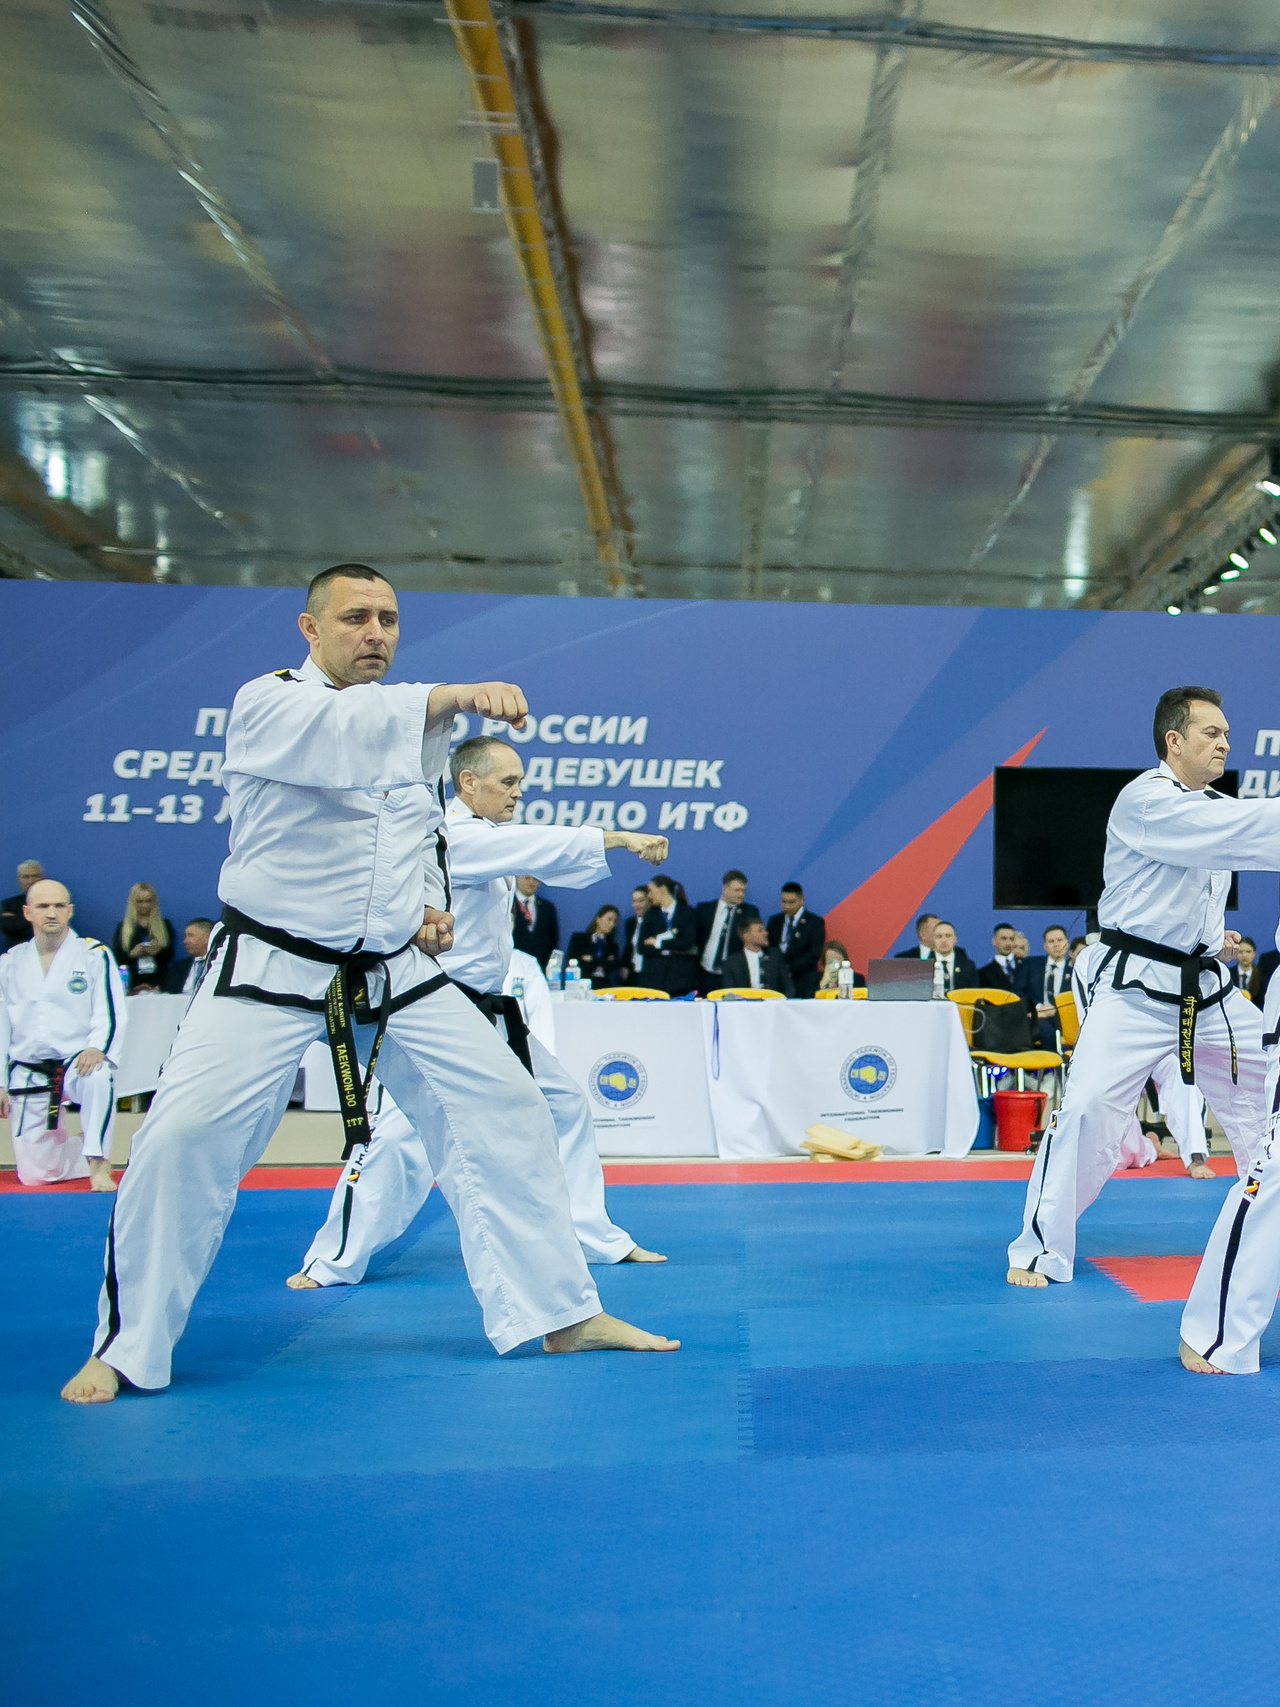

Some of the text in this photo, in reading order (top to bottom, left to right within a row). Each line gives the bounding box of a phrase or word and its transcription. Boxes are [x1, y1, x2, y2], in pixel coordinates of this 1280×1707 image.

[481, 714, 649, 745] РОССИИ
[113, 749, 224, 787] СРЕД
[519, 757, 725, 792] ДЕВУШЕК
[658, 801, 748, 831] ИТФ
[336, 1042, 357, 1107] TAEKWON-DO
